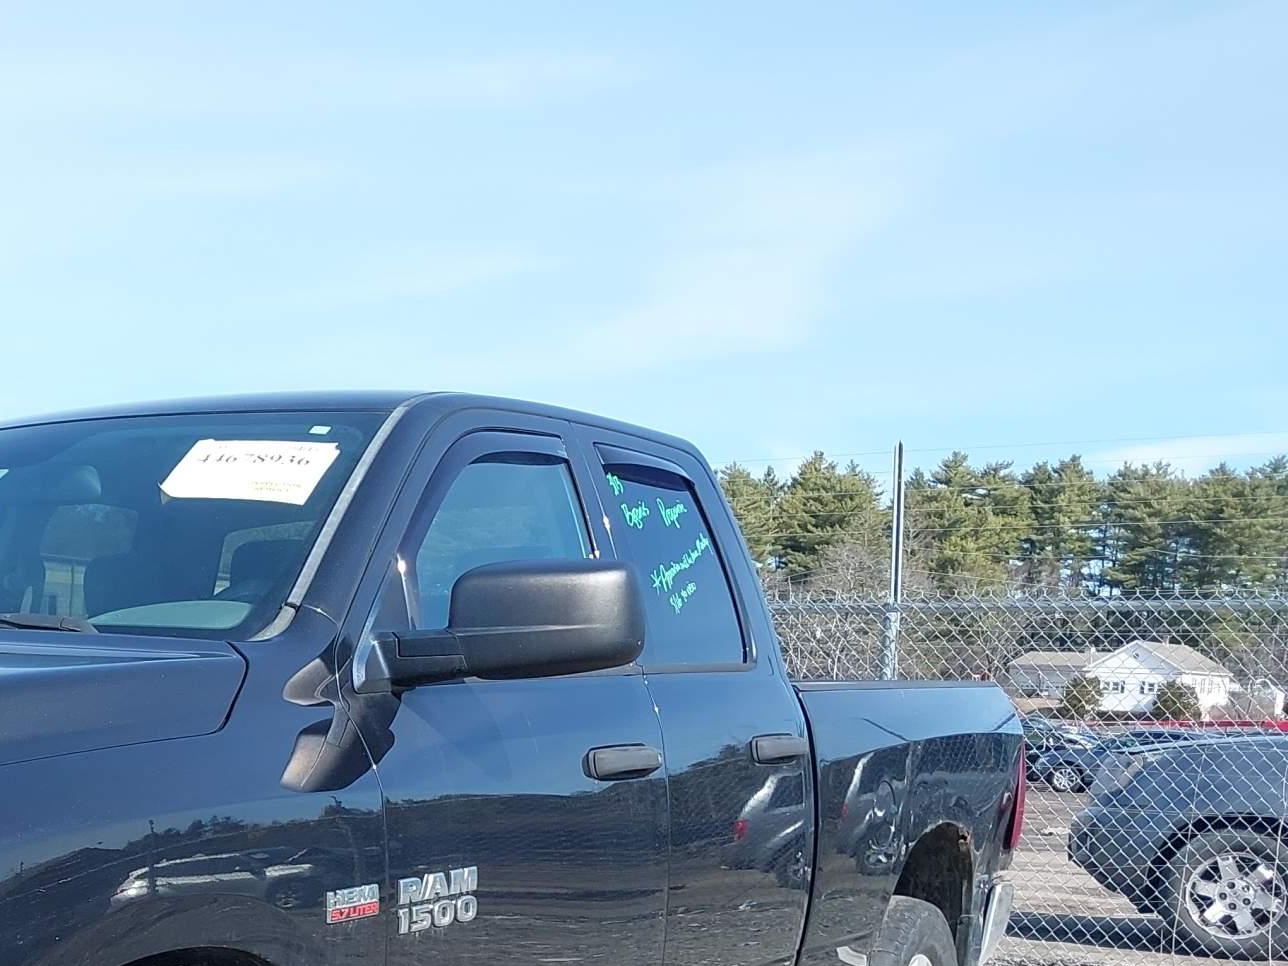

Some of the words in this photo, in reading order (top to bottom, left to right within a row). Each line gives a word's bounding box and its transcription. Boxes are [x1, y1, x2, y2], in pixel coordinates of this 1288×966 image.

[327, 884, 379, 909] HEMI
[398, 866, 478, 905] RAM
[350, 902, 378, 917] LITER
[398, 895, 478, 935] 1500
